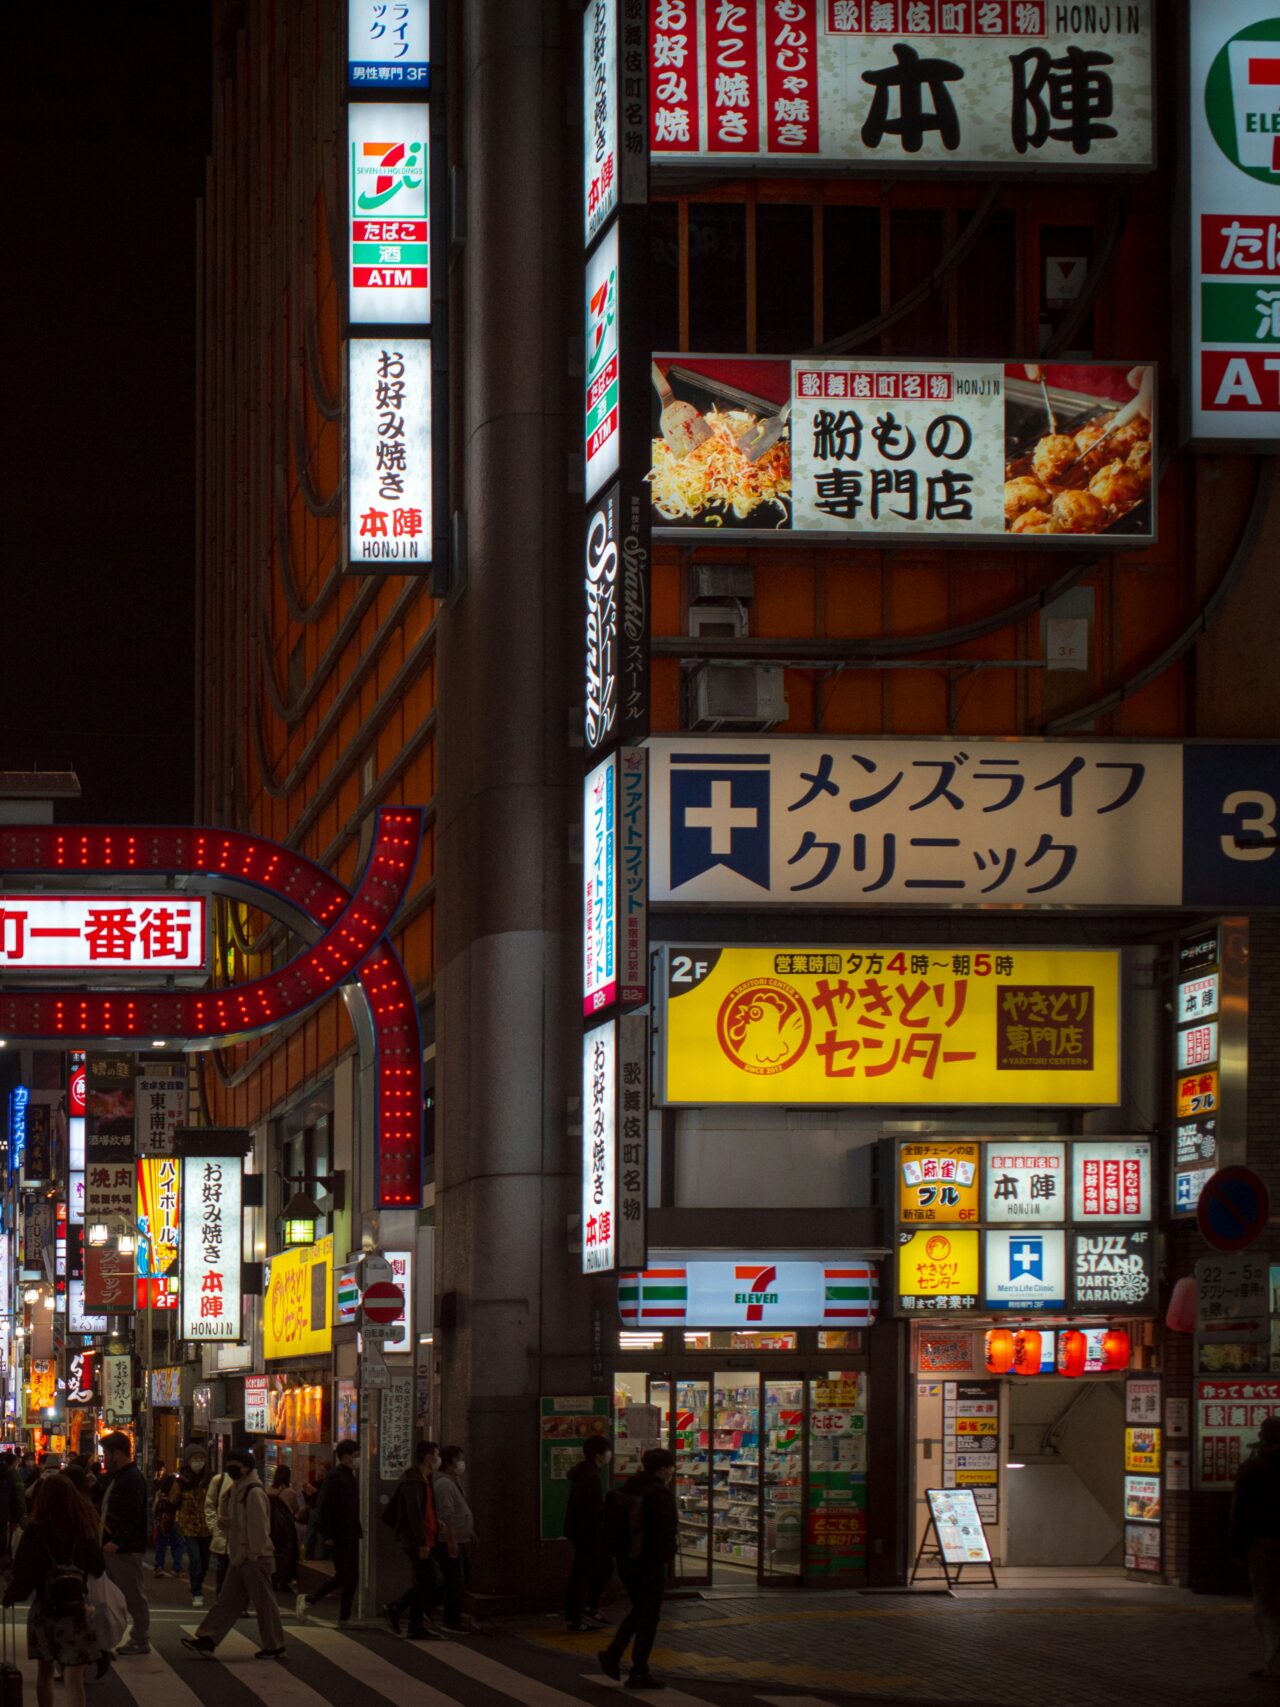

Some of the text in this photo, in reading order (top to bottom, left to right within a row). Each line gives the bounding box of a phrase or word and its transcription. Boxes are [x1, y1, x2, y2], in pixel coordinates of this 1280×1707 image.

[832, 1, 1043, 33] 歌舞伎町名物
[1056, 4, 1140, 35] HONJIN
[353, 67, 427, 80] 男性専門 3F
[774, 1, 811, 146] もんじゃ焼き
[860, 42, 1119, 155] 本陣
[364, 222, 416, 240] たばこ
[379, 245, 401, 263] 酒
[368, 270, 412, 286] ATM
[591, 367, 613, 404] たばこ
[801, 373, 1000, 398] 歌舞伎町名物 HONJIN
[597, 395, 607, 417] 酒
[376, 350, 407, 500] お好み焼き
[592, 417, 612, 453] ATM
[813, 410, 972, 462] 粉もの
[814, 469, 974, 522] 専門店
[360, 507, 423, 538] 本陣
[363, 541, 418, 559] HONJIN
[626, 645, 644, 719] スパークル
[787, 751, 1145, 818] メンズライフ
[624, 772, 643, 914] ファイトフィット
[787, 832, 1077, 894] クリニック
[594, 806, 603, 985] ファイトフィット
[628, 917, 638, 982] 新宿東口駅前
[776, 955, 841, 974] 営業時間
[671, 956, 708, 984] 2F
[622, 989, 643, 1001] B2F
[812, 978, 967, 1029] やきとり
[1003, 991, 1088, 1022] やきとり
[815, 1030, 977, 1080] センター
[1006, 1025, 1082, 1055] 専門店
[1009, 1058, 1083, 1066] YAKITORI CENTER
[150, 1092, 166, 1149] 東南荘
[593, 1040, 605, 1205] お好み焼き
[623, 1062, 641, 1221] 歌舞伎町名物
[904, 1146, 974, 1156] 全国チェーンの店
[923, 1159, 956, 1179] 麻雀
[918, 1186, 959, 1206] ブル
[994, 1174, 1056, 1200] 本陣
[1085, 1162, 1097, 1212] お好み焼
[1105, 1162, 1118, 1211] たこ焼き
[160, 1161, 176, 1243] ハイボール
[202, 1163, 223, 1264] お好み焼き
[903, 1209, 975, 1220] 新宿店 6F
[1007, 1204, 1040, 1215] HONJIN
[585, 1210, 611, 1247] 本陣
[1077, 1233, 1148, 1255] BUZZ 4F
[917, 1263, 957, 1276] やきとり
[1077, 1255, 1143, 1273] STAND
[200, 1270, 224, 1318] 本陣
[917, 1276, 960, 1289] センター
[997, 1284, 1054, 1292] Men's Life Clinic
[157, 1295, 176, 1307] 2F
[902, 1296, 975, 1309] 朝まで営業中
[1034, 1301, 1044, 1309] 3F
[191, 1322, 233, 1335] HONJIN
[811, 1415, 864, 1429] たばこ 酒
